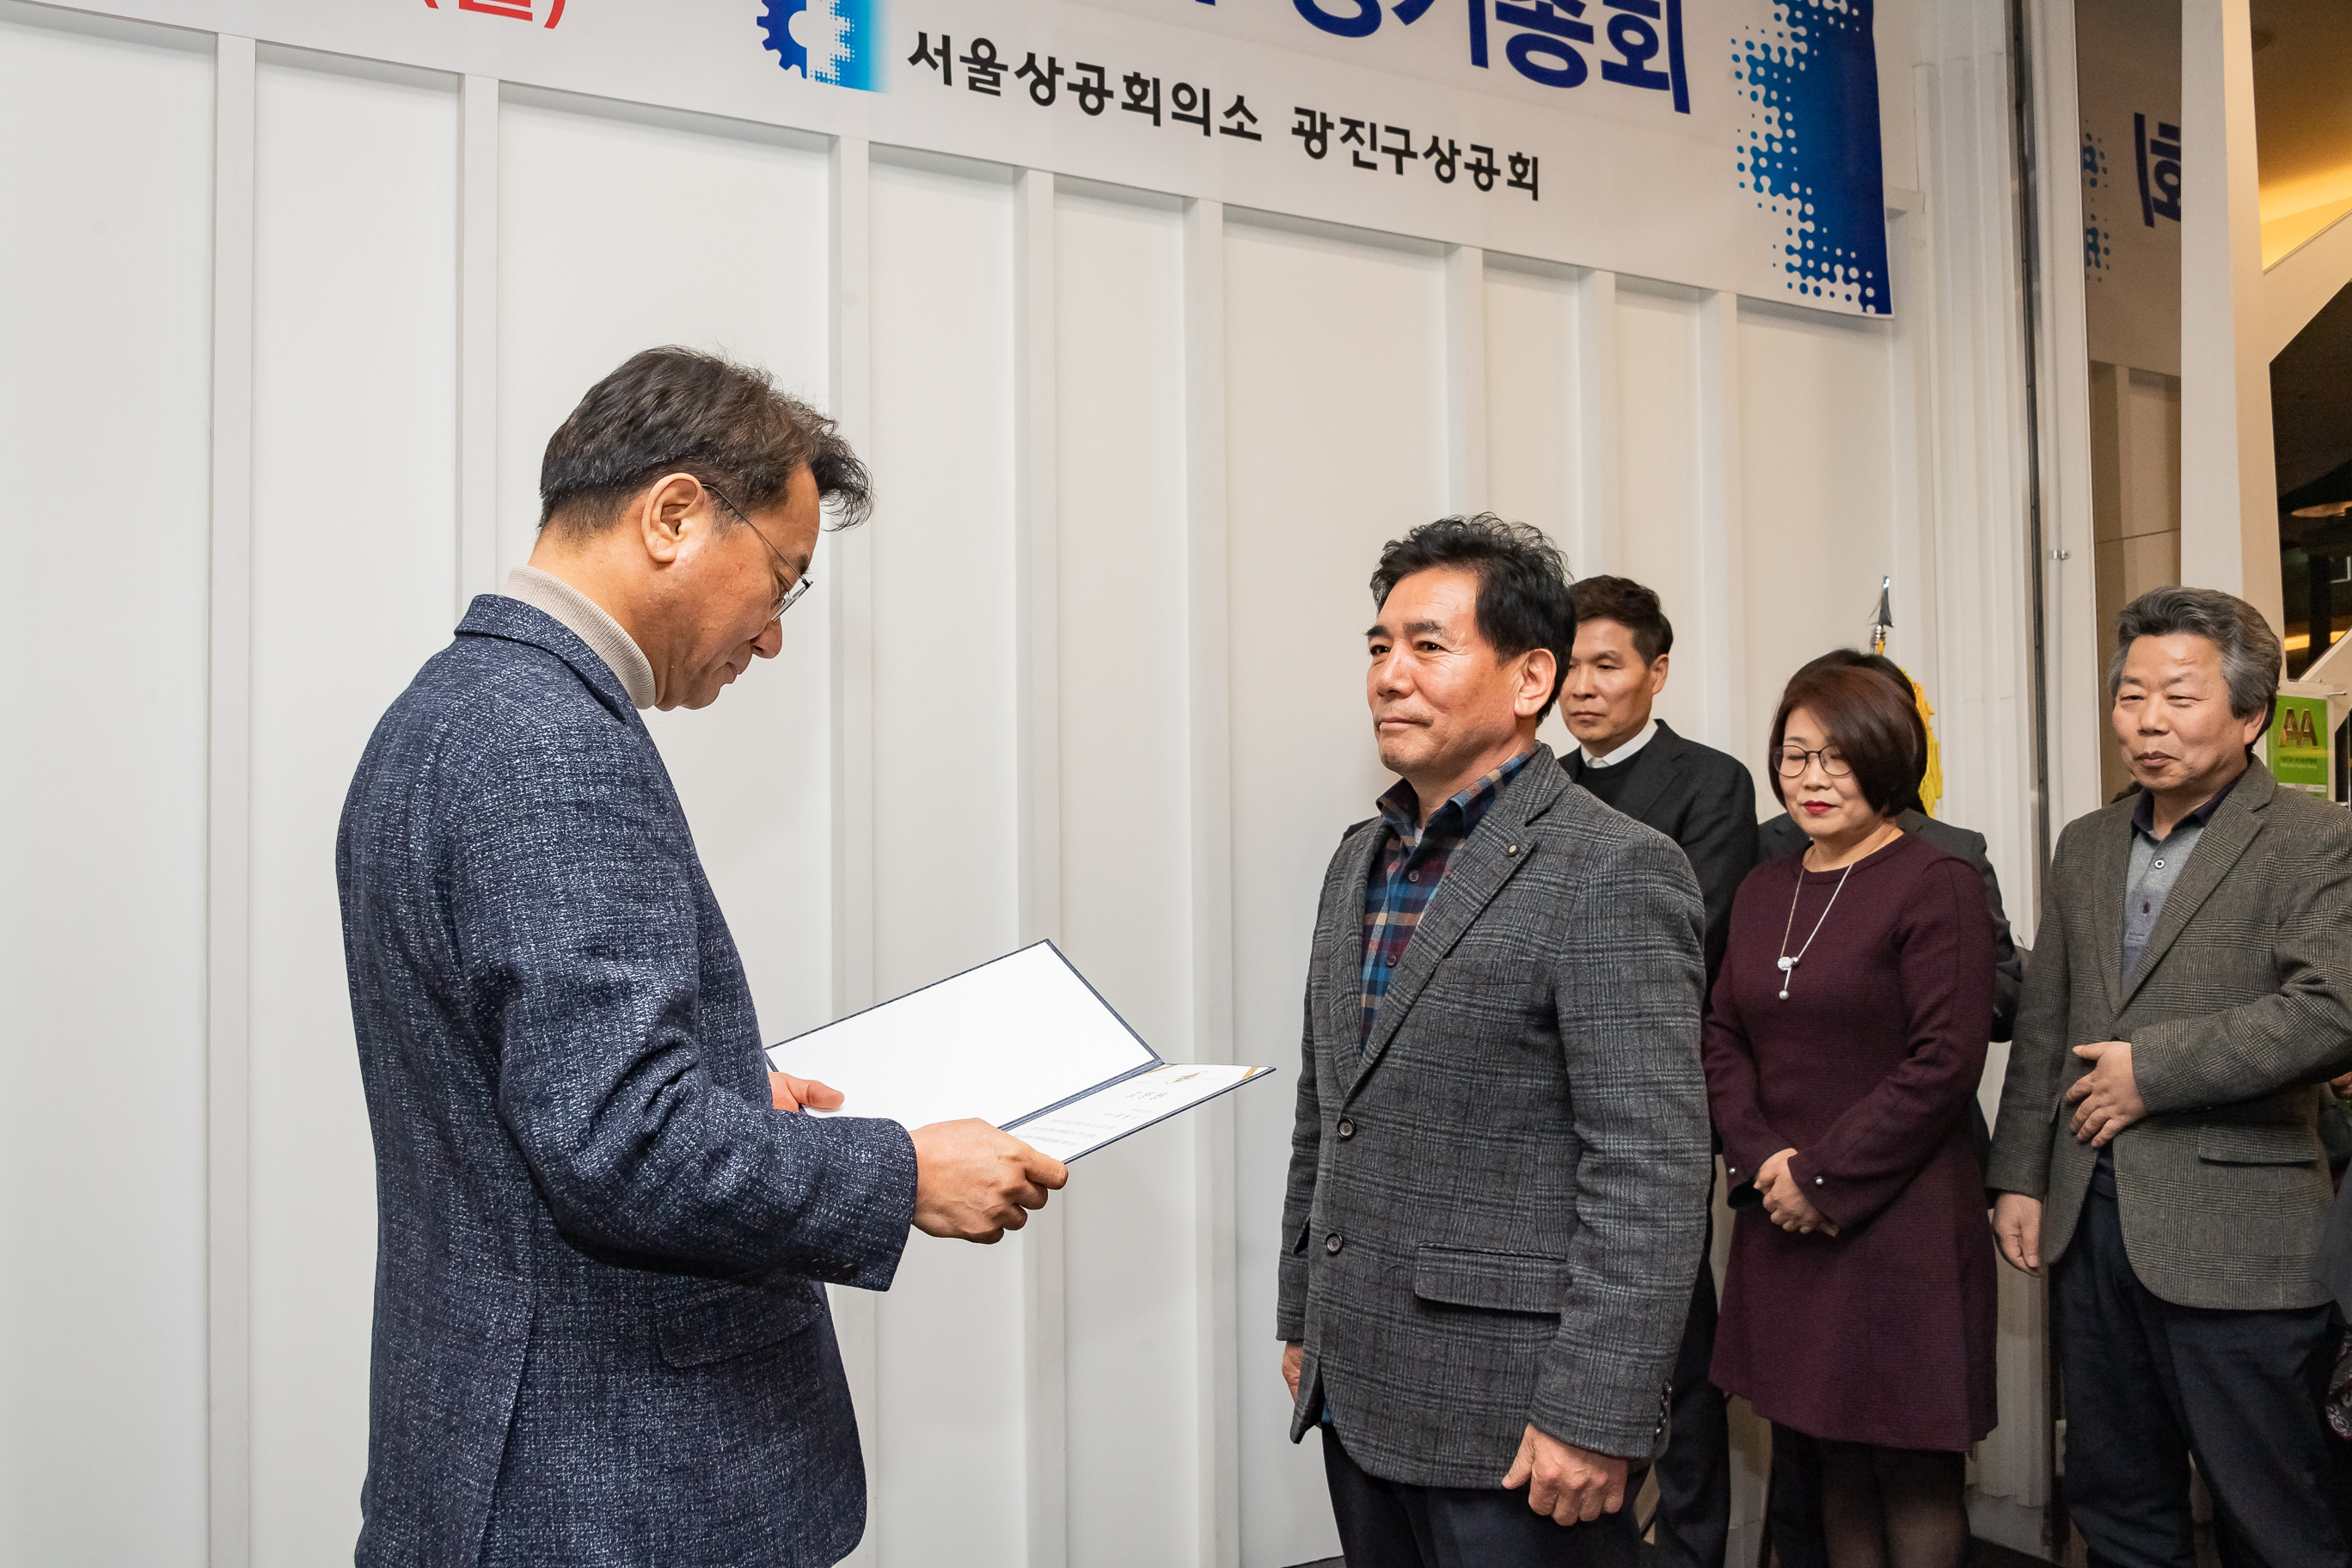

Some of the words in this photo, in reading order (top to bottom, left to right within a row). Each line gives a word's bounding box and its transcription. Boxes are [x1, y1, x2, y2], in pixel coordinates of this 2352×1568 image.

[907, 31, 1262, 143] 서울상공회의소
[1291, 107, 1540, 201] 광진구상공회
[1293, 0, 1691, 114] 총회
